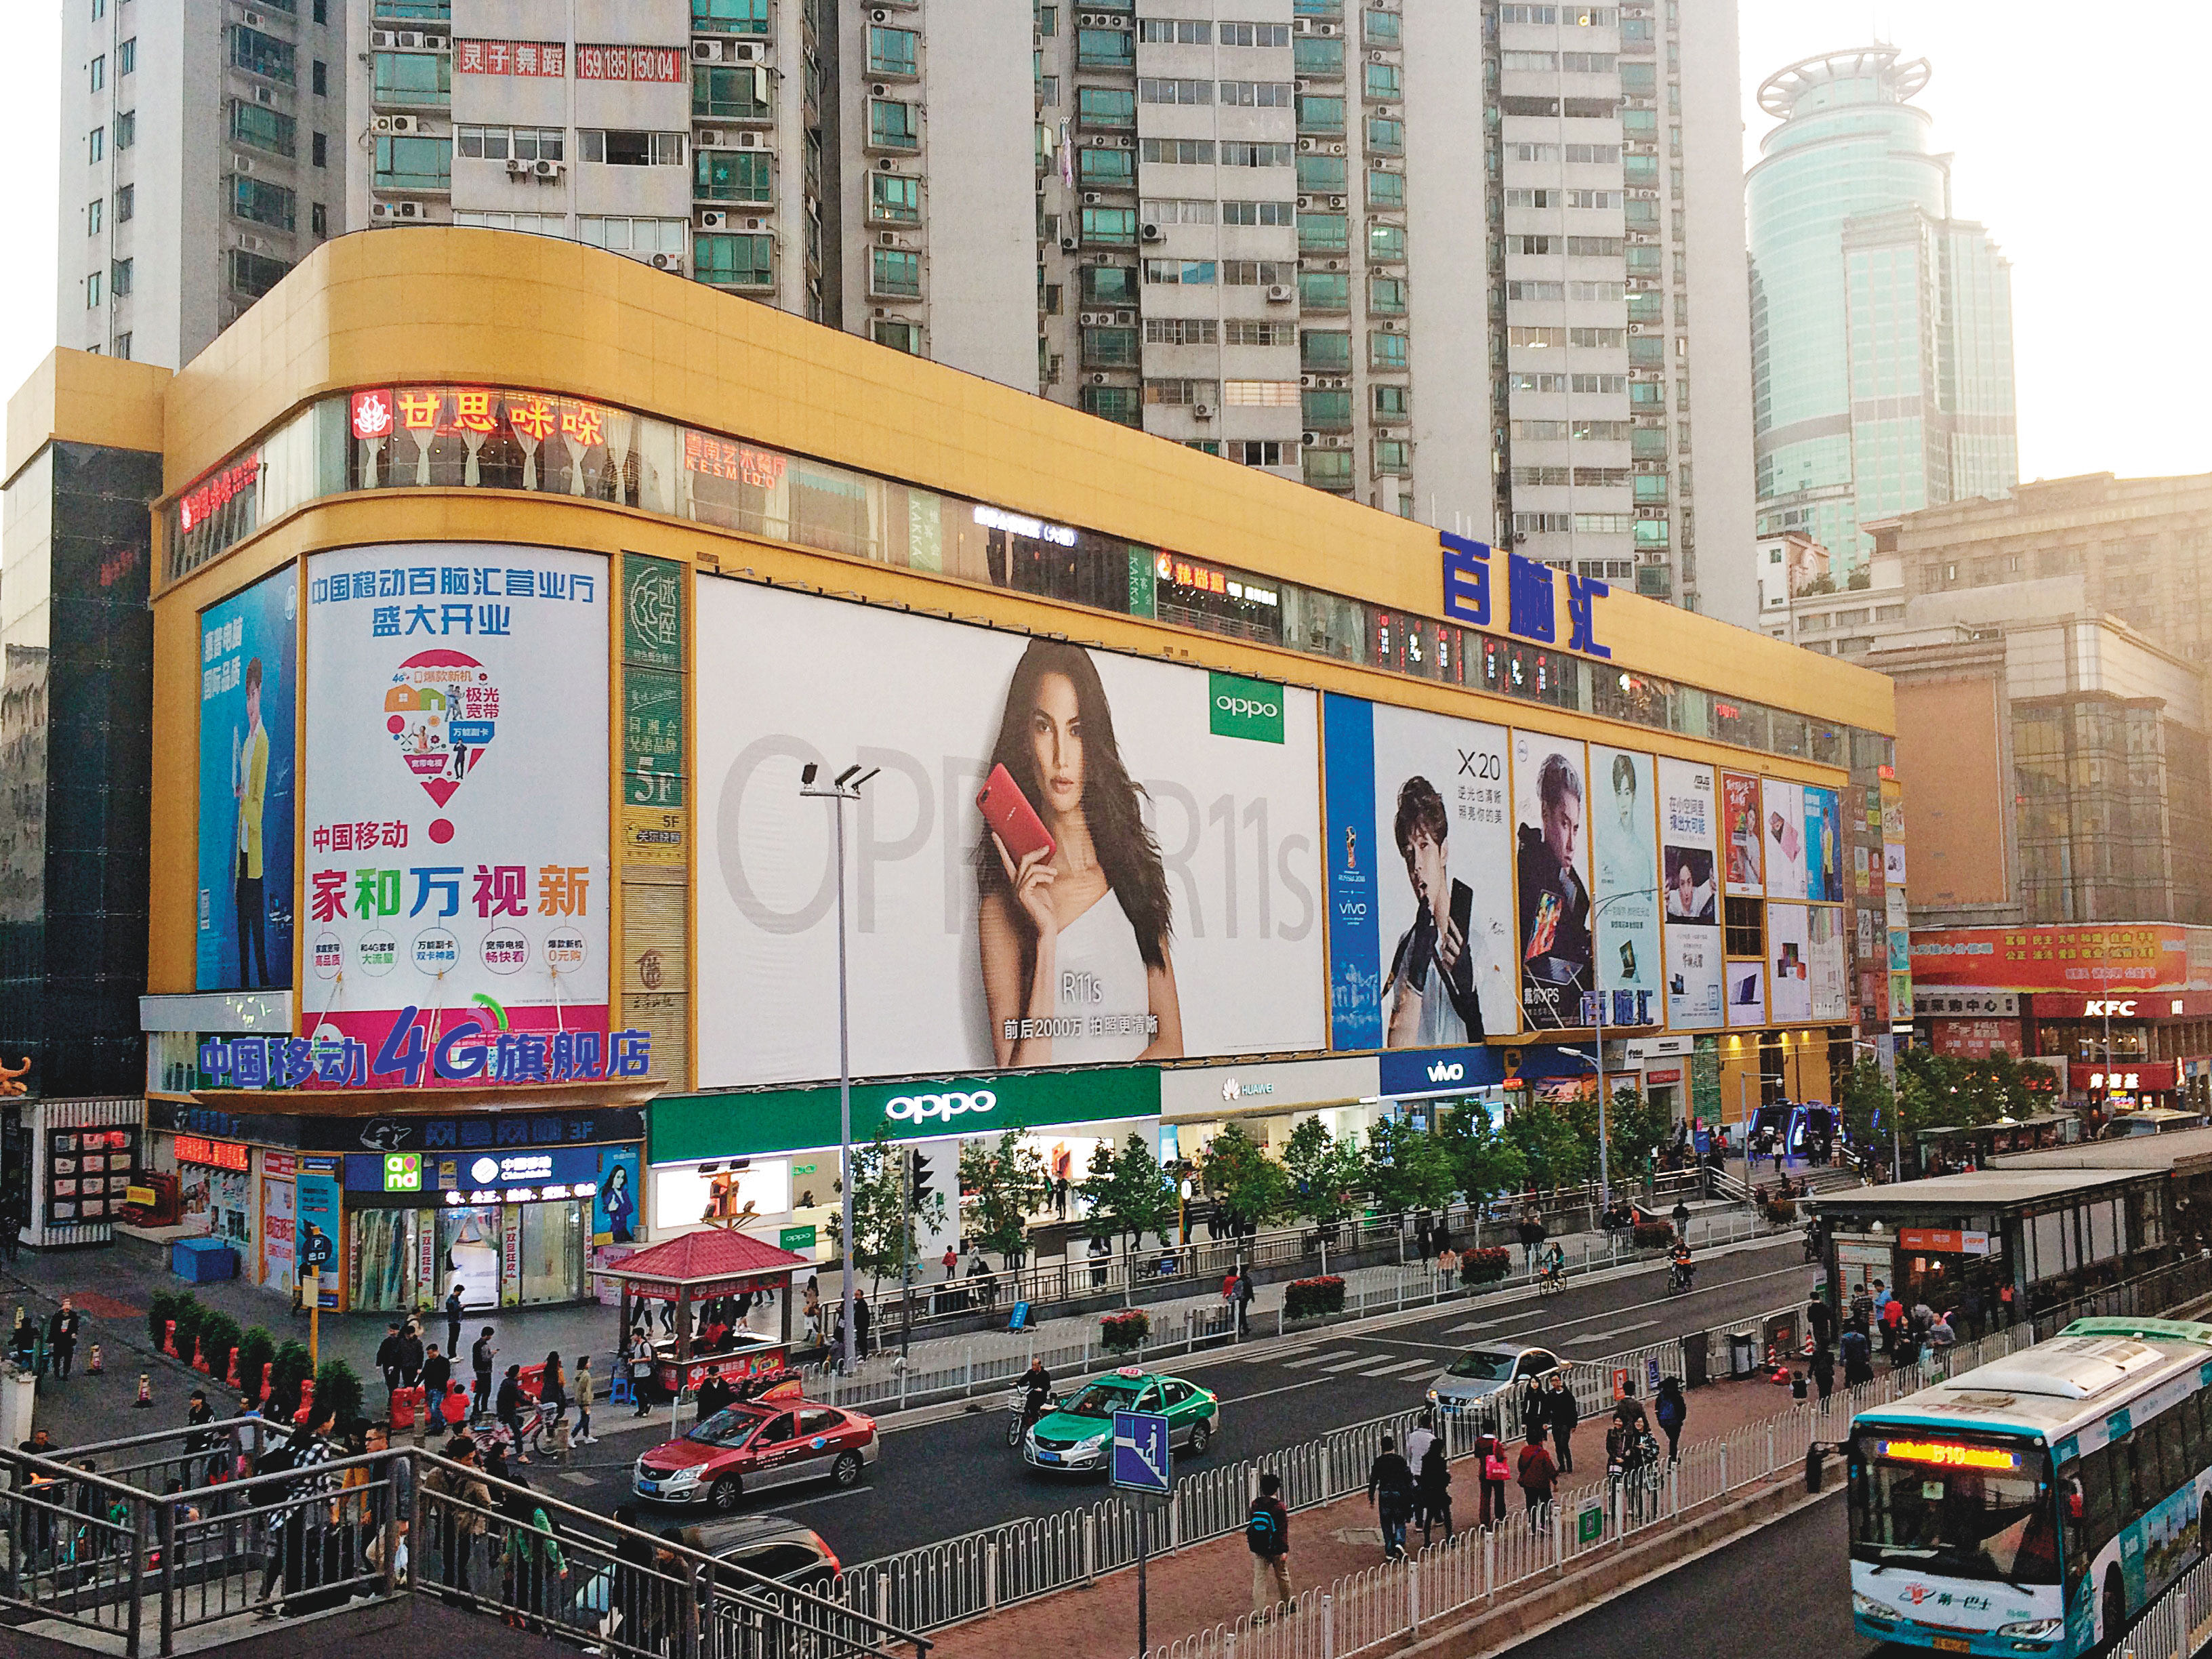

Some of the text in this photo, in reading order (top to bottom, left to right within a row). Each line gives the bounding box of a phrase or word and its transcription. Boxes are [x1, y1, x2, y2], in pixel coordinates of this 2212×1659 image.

[464, 44, 563, 76] 灵子舞蹈
[398, 391, 604, 447] 甘思咪哆
[311, 567, 595, 605] 中国移动百脑汇营业厅
[1441, 531, 1612, 659] 百脑汇
[372, 603, 511, 638] 盛大开业
[466, 687, 499, 703] 极光
[466, 703, 499, 719] 宽带
[453, 727, 489, 737] 万能副卡
[1458, 749, 1500, 781] X20
[663, 815, 679, 827] 5F
[312, 819, 409, 854] 中国移动
[1338, 900, 1367, 915] vivo
[417, 940, 454, 950] 万能副卡
[485, 940, 525, 949] 宽带电视
[547, 939, 583, 949] 爆款新机
[314, 954, 341, 968] 高品质
[361, 953, 394, 965] 大流量
[485, 950, 525, 964] 畅快看
[548, 949, 581, 962] 0元购
[1062, 972, 1103, 1004] R11s
[1524, 987, 1559, 1005] 戴尔XPS
[2084, 1000, 2138, 1017] KFC
[1004, 1015, 1159, 1040] 前后2000万 拍照更清晰
[1427, 1060, 1464, 1083] vivo
[1242, 1082, 1274, 1096] HUAWEI
[1938, 1592, 1992, 1611] 第一巴士
